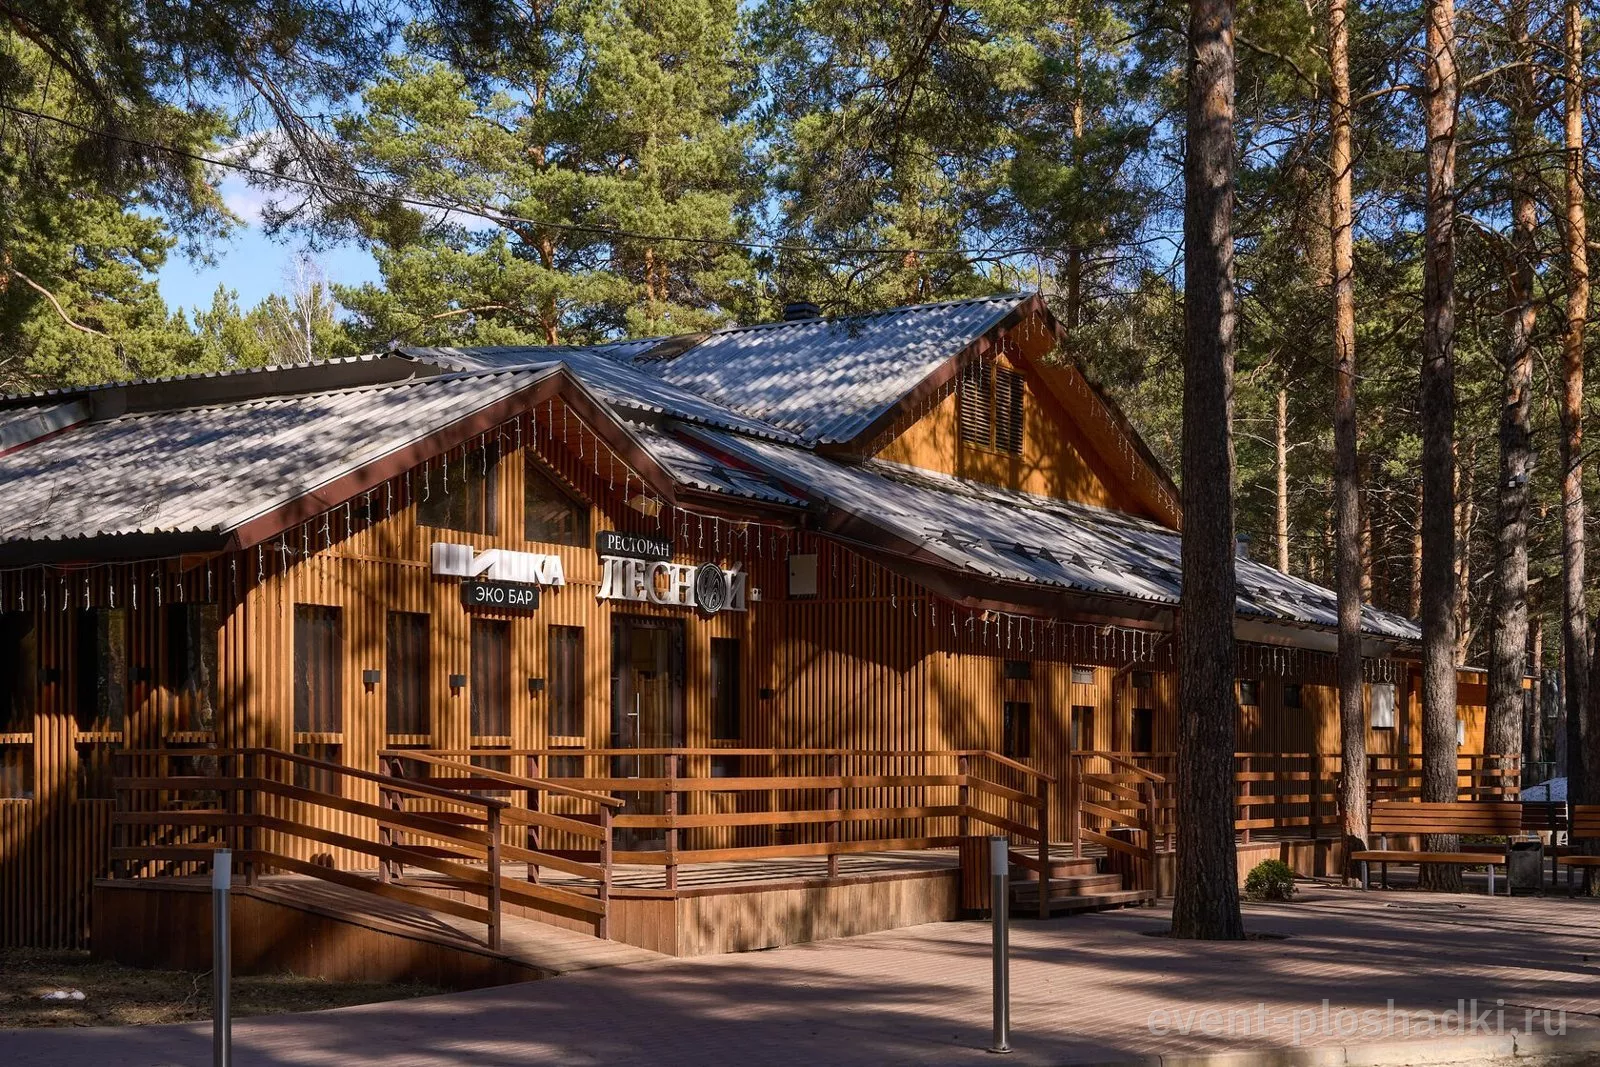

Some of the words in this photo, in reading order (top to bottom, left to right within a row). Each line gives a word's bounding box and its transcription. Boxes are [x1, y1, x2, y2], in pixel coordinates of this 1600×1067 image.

[607, 534, 669, 557] РЕСТОРАН
[432, 542, 565, 586] ШИШКА
[475, 586, 504, 603] ЭКО
[508, 589, 533, 605] БАР
